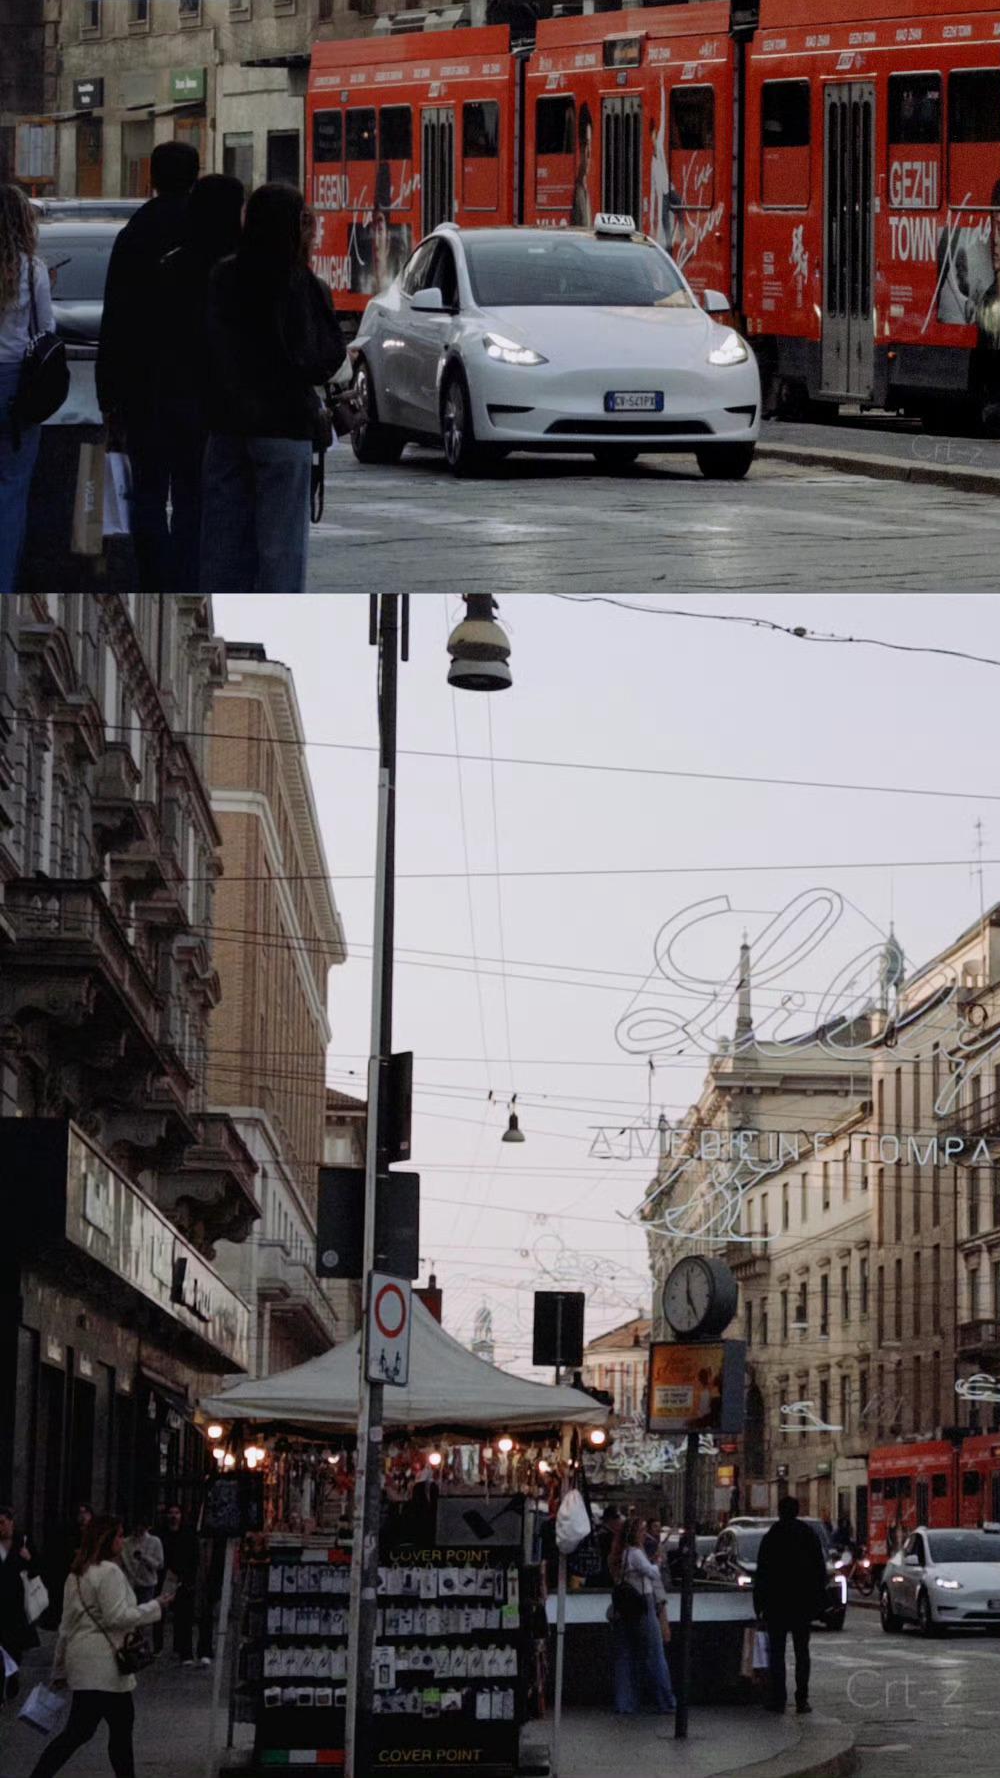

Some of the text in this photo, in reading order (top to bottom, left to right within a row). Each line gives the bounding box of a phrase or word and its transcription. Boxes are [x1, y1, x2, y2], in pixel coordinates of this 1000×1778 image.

[313, 175, 349, 209] LEGEND
[889, 161, 939, 206] GEZHI
[601, 215, 632, 227] TAXI
[889, 216, 939, 261] TOWN
[447, 1549, 491, 1562] POINT
[379, 1748, 482, 1762] COVER POINT
